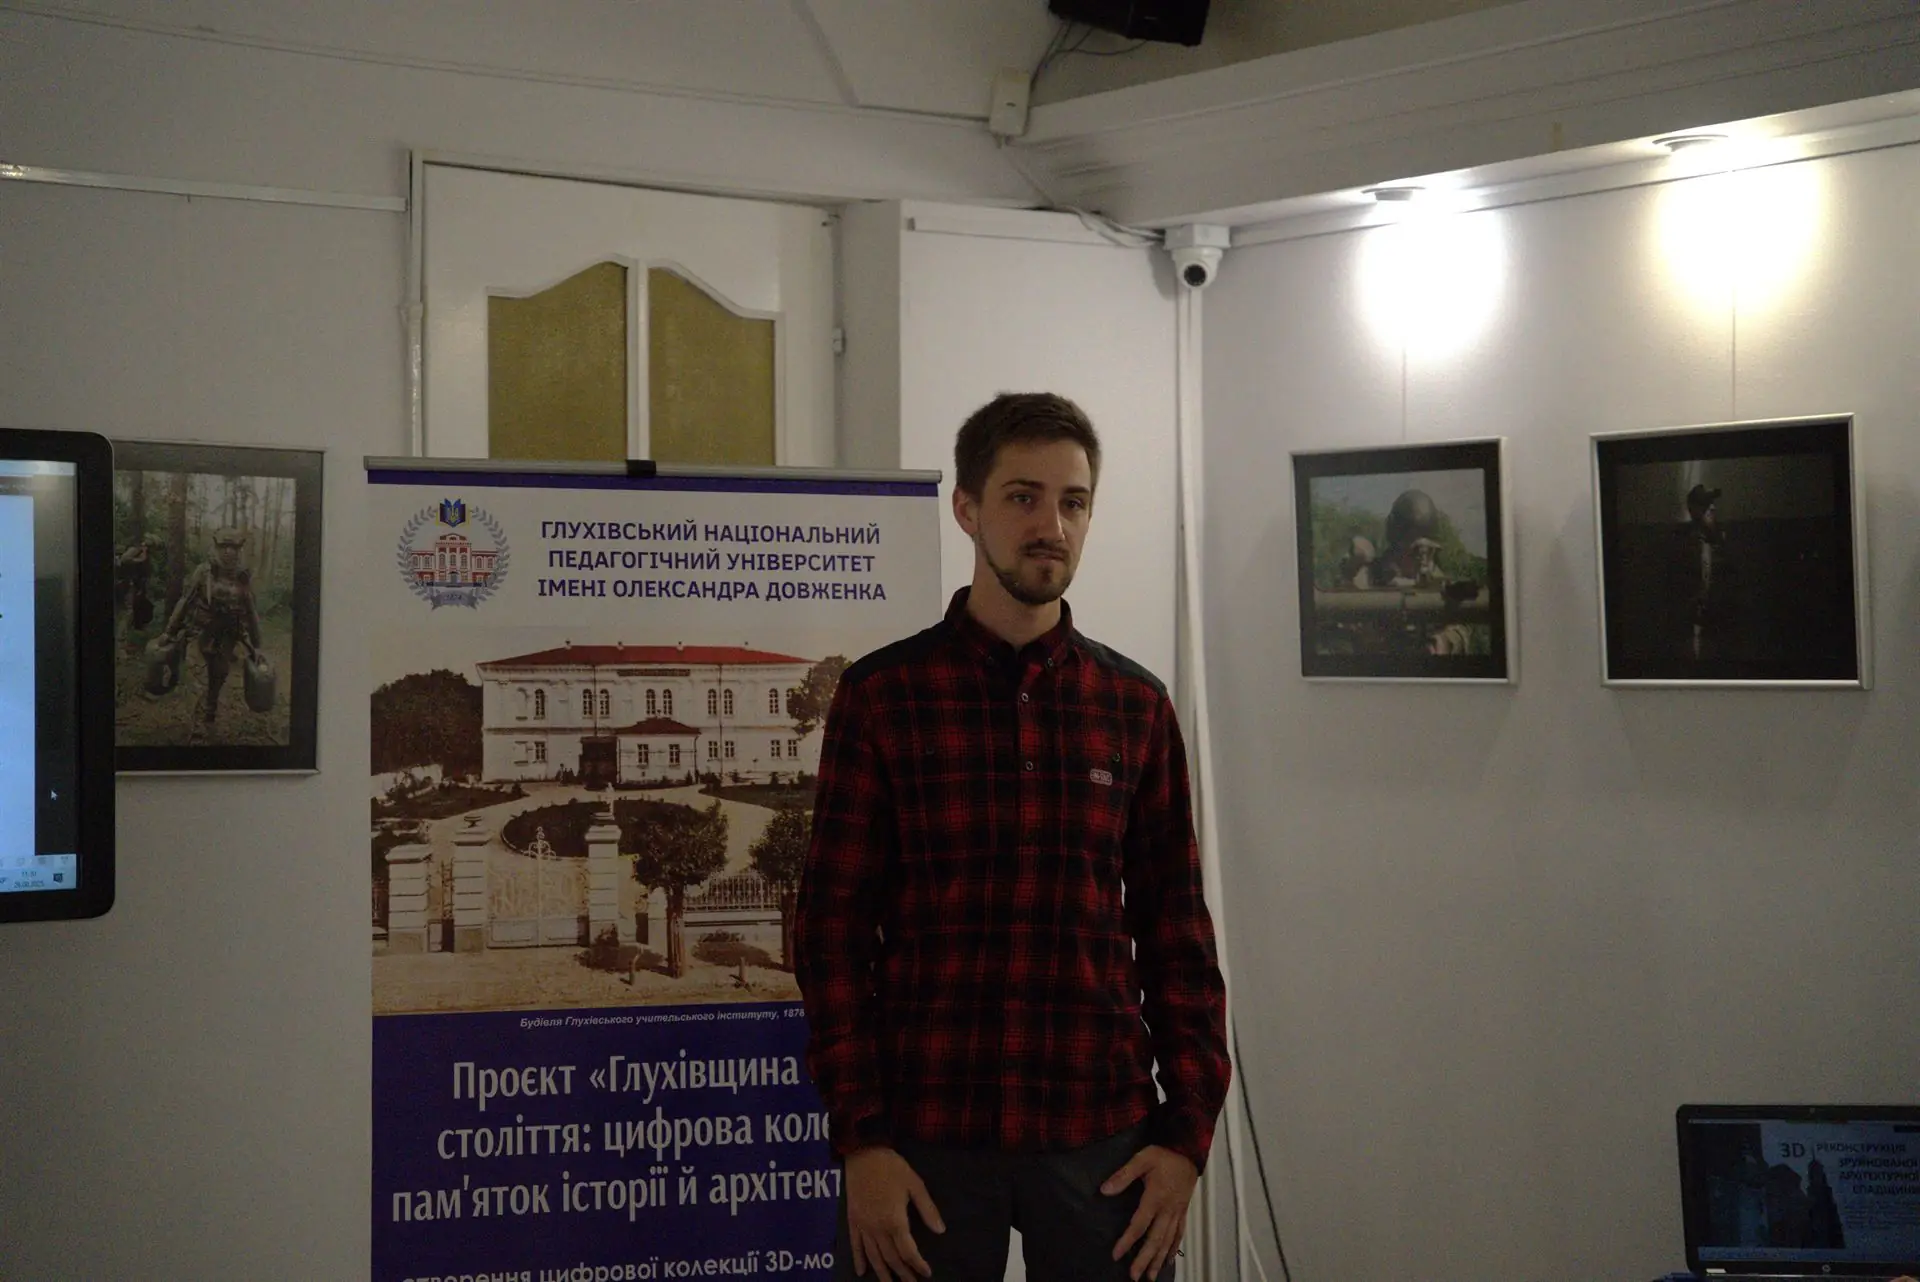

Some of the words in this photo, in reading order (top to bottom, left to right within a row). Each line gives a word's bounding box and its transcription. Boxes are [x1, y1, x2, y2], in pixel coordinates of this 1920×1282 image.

[541, 520, 697, 541] ГЛУХІВСЬКИЙ
[704, 522, 881, 546] НАЦІОНАЛЬНИЙ
[548, 548, 720, 572] ПЕДАГОГІЧНИЙ
[726, 553, 876, 573] УНІВЕРСИТЕТ
[537, 578, 607, 598] ІМЕНІ
[612, 580, 760, 602] ОЛЕКСАНДРА
[765, 582, 887, 602] ДОВЖЕНКА
[519, 1016, 564, 1029] Будівля
[564, 1014, 634, 1027] Глухівського
[635, 1012, 716, 1026] учительського
[716, 1010, 780, 1022] інституту,
[783, 1008, 806, 1018] 1878
[453, 1060, 577, 1112] Проєкт
[588, 1048, 801, 1105] «Глухівщина
[437, 1114, 591, 1160] століття:
[604, 1106, 754, 1162] цифрова
[1780, 1142, 1805, 1157] 3D
[392, 1174, 551, 1222] пам'яток
[562, 1165, 668, 1222] історії
[678, 1165, 698, 1205] й
[539, 1257, 659, 1282] цифрової
[664, 1250, 759, 1278] колекції
[765, 1250, 835, 1272] 3D-мо
